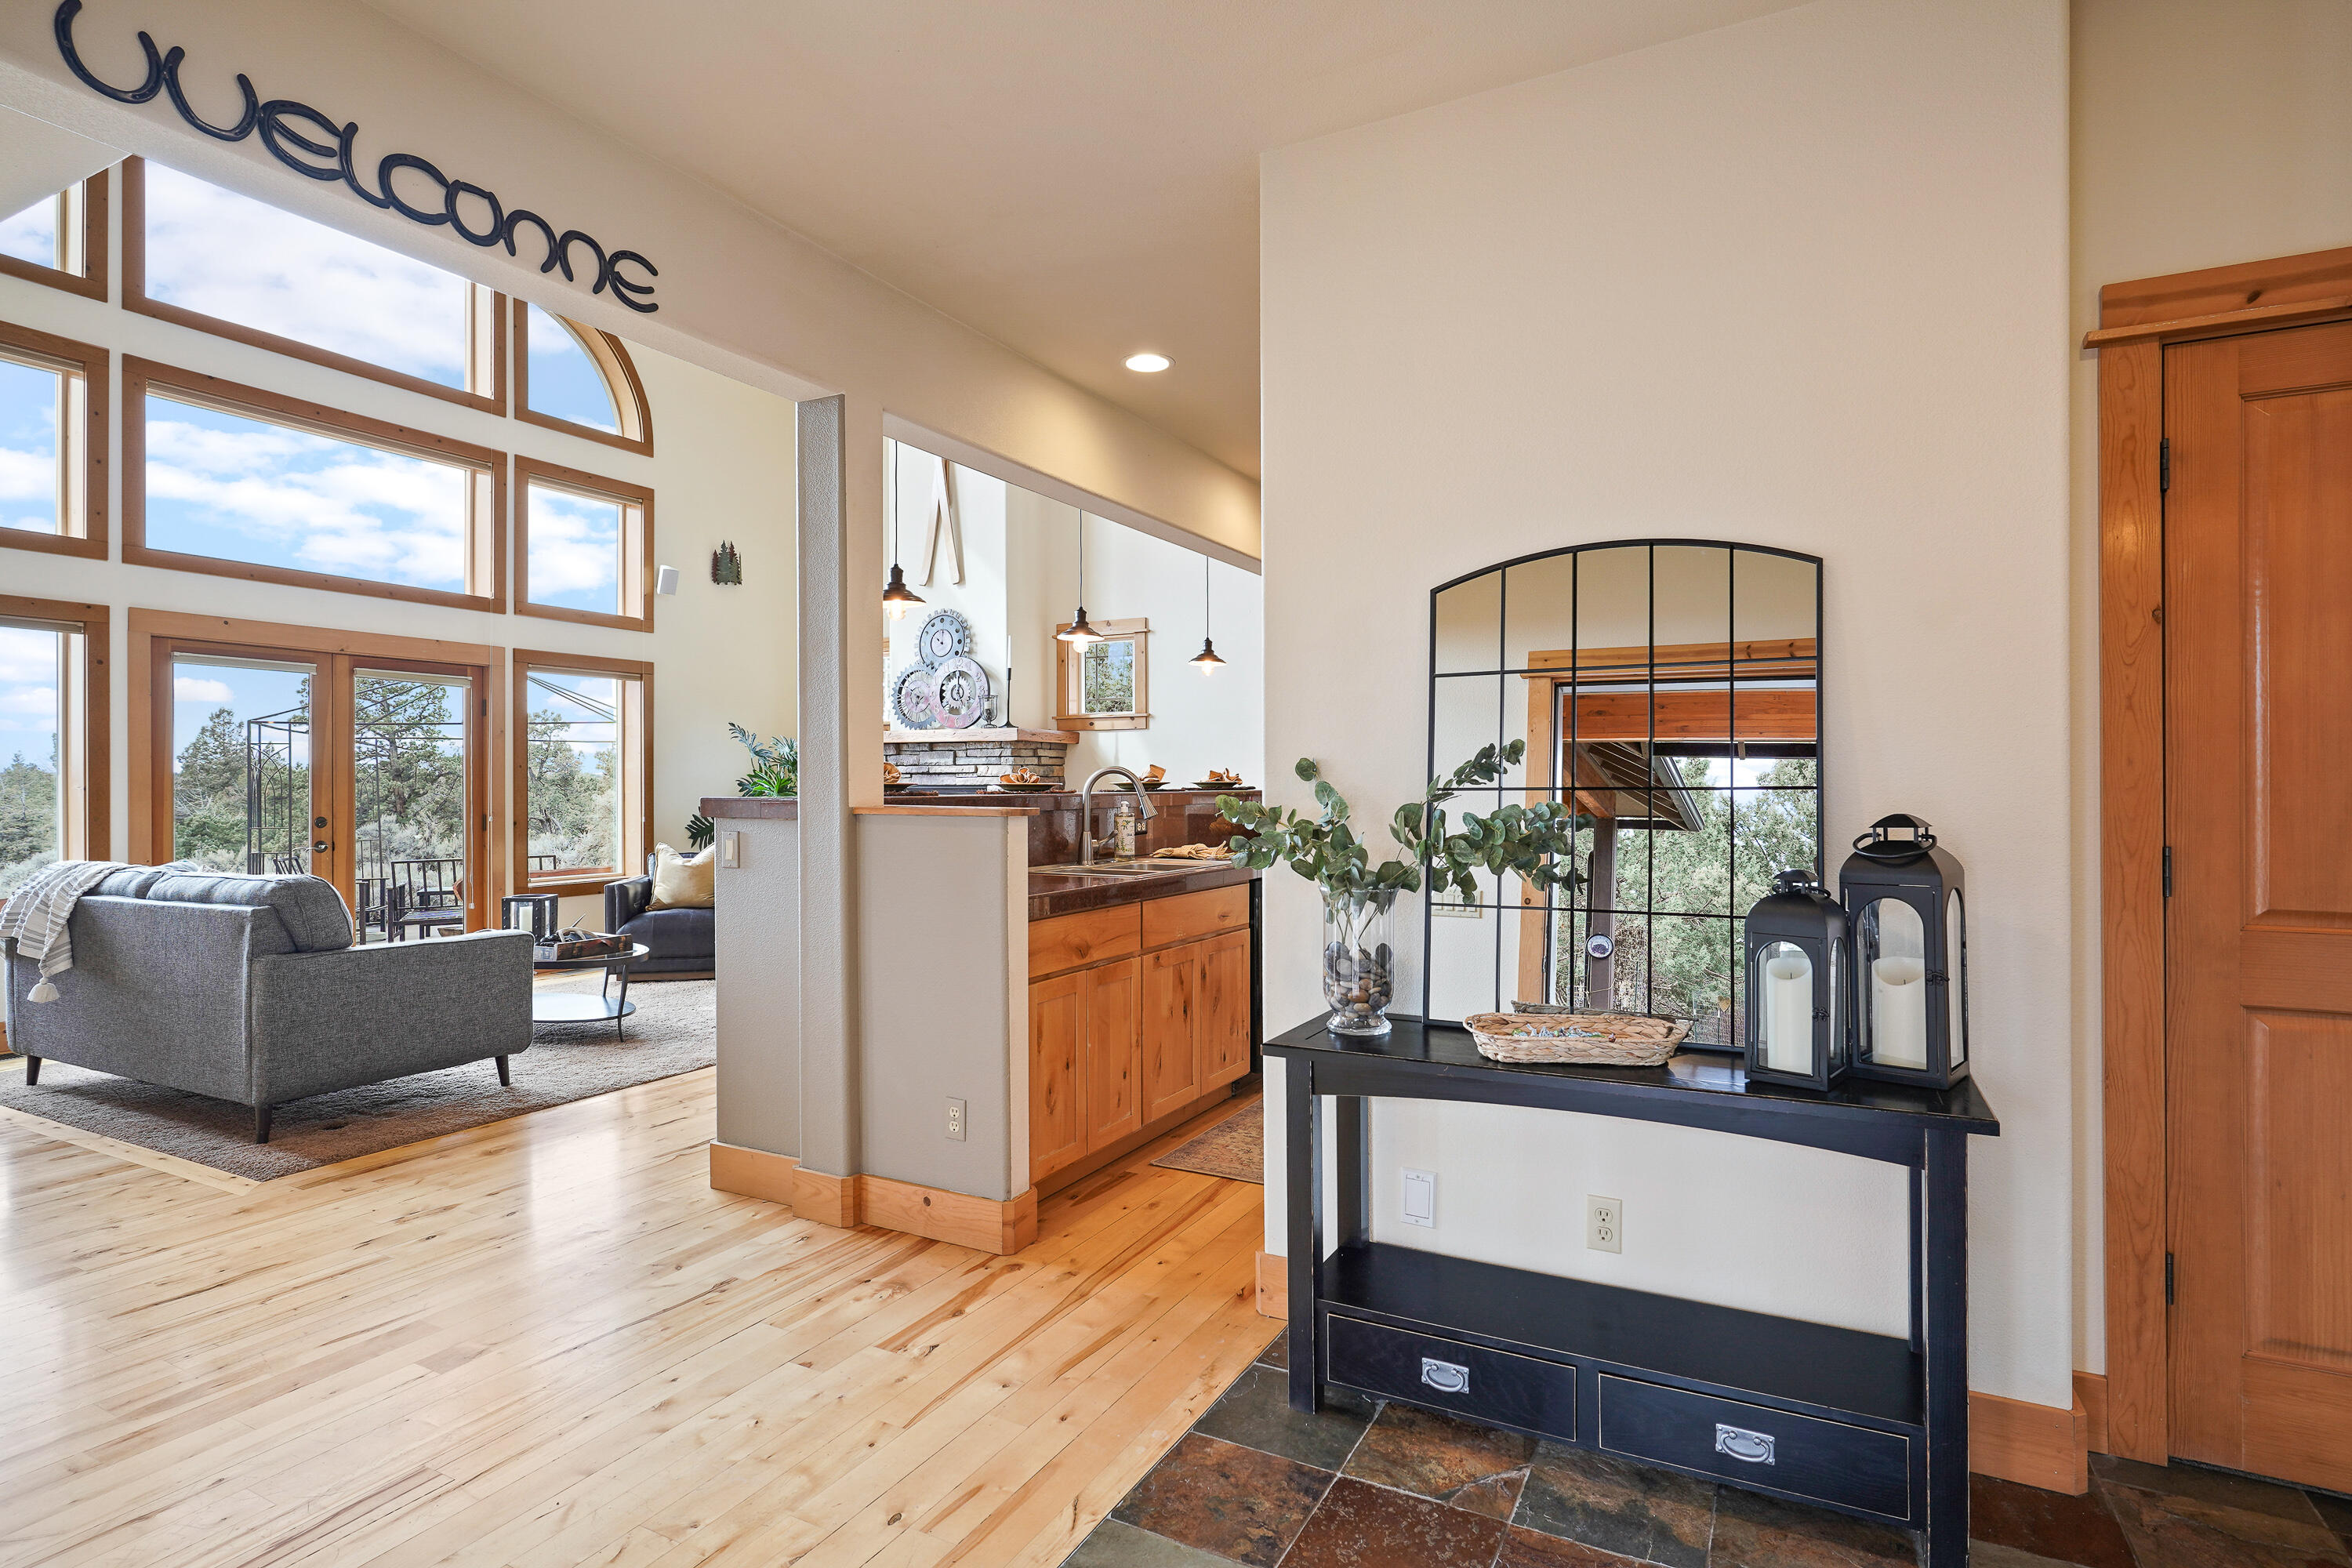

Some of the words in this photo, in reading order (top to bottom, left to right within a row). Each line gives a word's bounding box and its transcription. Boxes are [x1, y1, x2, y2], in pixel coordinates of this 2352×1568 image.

[975, 672, 982, 683] 2
[934, 704, 941, 714] 8
[954, 716, 960, 727] 6
